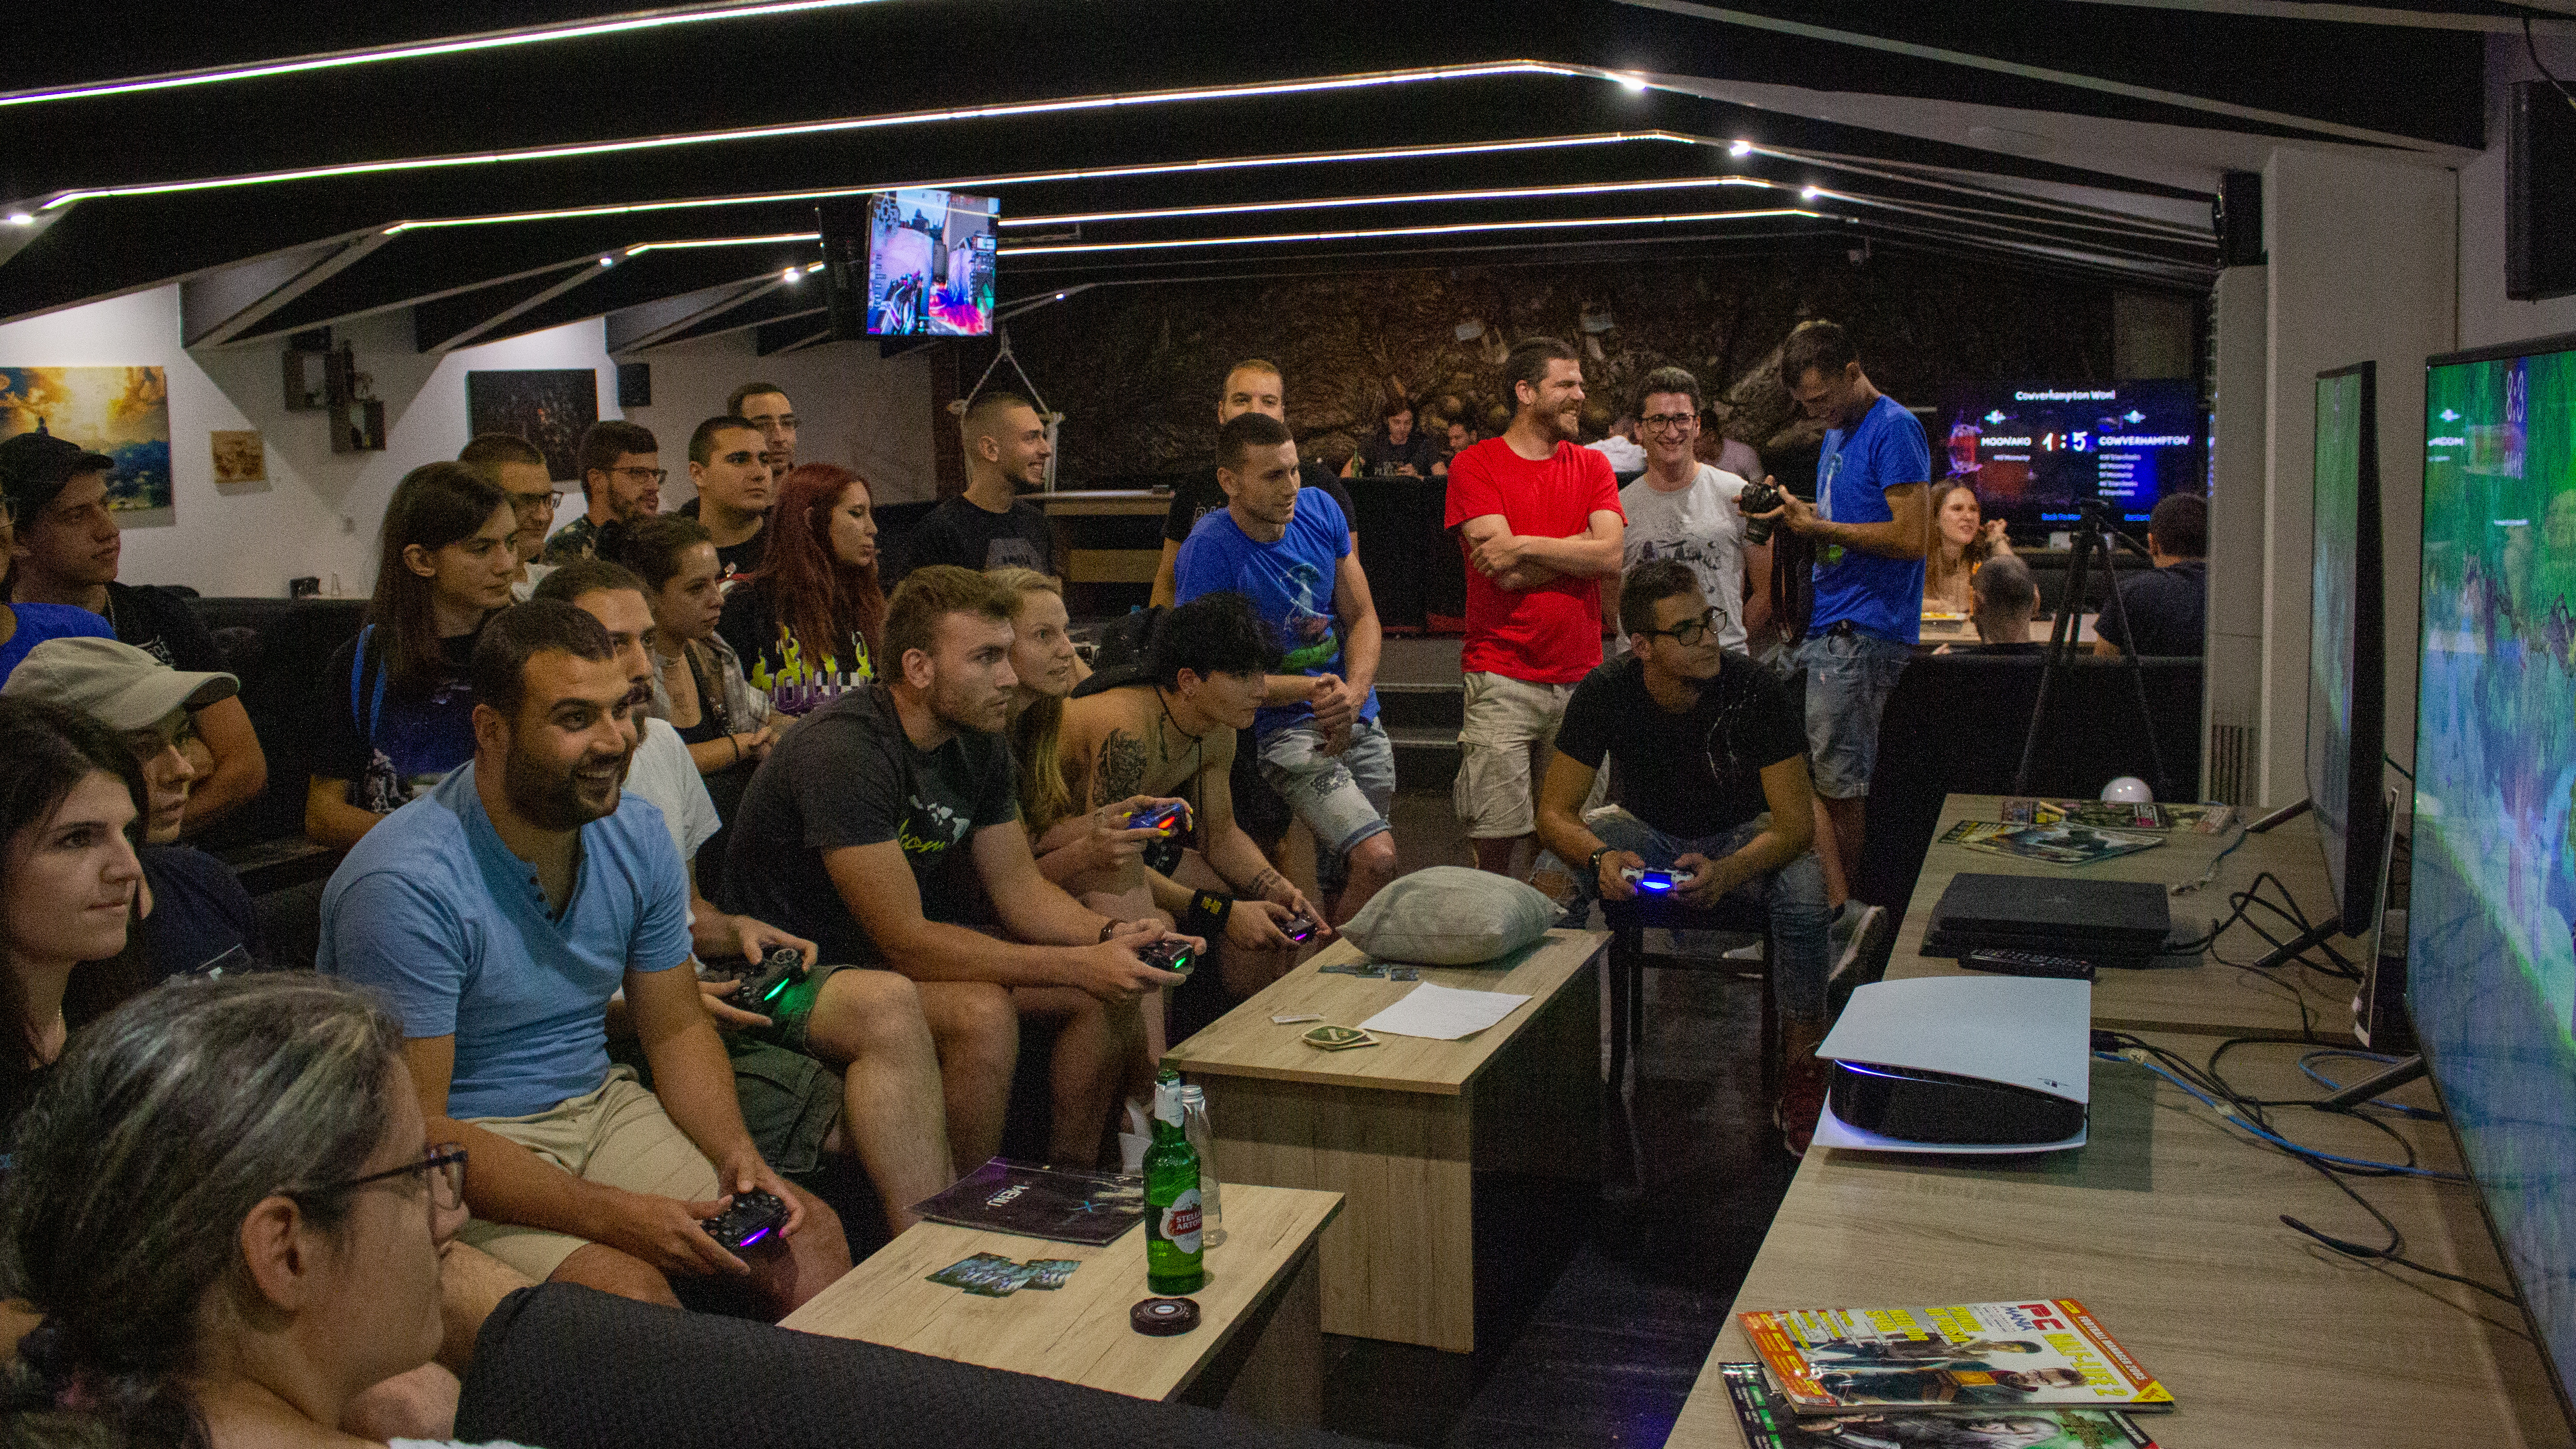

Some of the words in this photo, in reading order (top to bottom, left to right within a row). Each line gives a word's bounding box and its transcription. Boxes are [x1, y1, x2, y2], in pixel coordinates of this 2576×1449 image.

[2098, 435, 2190, 446] COWVERHAMPTON
[2005, 1307, 2035, 1332] MANIA
[2018, 1304, 2066, 1330] PC
[2043, 1333, 2120, 1386] HALF-LIFE
[2094, 1388, 2128, 1397] 2
